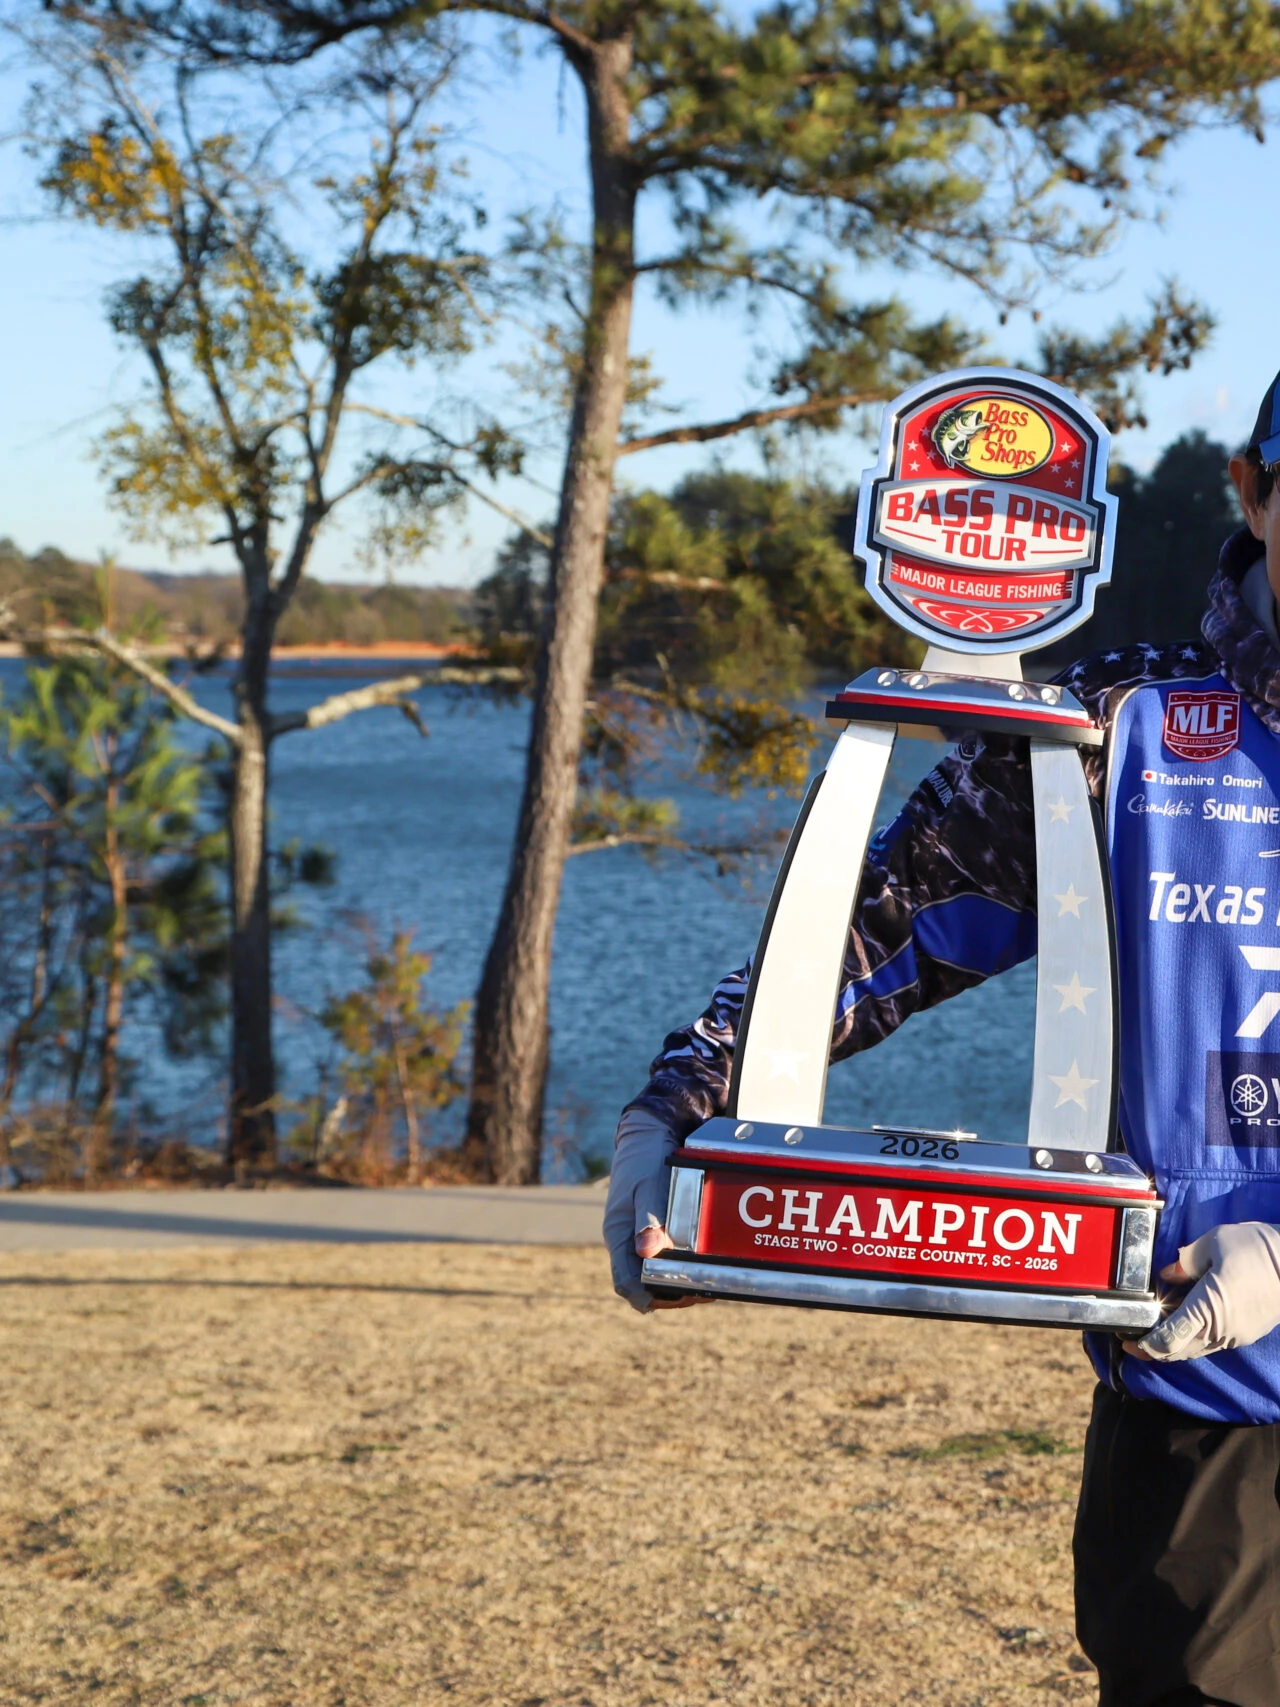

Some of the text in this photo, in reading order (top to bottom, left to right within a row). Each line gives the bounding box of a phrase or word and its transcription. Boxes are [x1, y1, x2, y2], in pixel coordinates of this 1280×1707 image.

[984, 402, 1029, 427] Bass
[984, 422, 1017, 445] Pro
[981, 441, 1036, 470] Shops
[887, 489, 1086, 542] BASS PRO
[941, 529, 1026, 561] TOUR
[900, 567, 1062, 599] MAJOR LEAGUE FISHING
[1172, 704, 1233, 735] MLF
[1189, 736, 1209, 745] LEAGUE
[1210, 734, 1233, 745] FISHING
[1159, 773, 1263, 789] Takahiro Omori
[1203, 798, 1280, 824] SUNLINE
[1148, 871, 1266, 925] Texas
[879, 1135, 960, 1161] 2026
[738, 1185, 1083, 1255] CHAMPION
[754, 1233, 799, 1249] STAGE
[803, 1238, 838, 1252] TWO
[851, 1243, 916, 1261] OCONEE
[920, 1249, 988, 1267] COUNTY,
[991, 1255, 1011, 1268] SC
[1024, 1257, 1059, 1271] 2026
